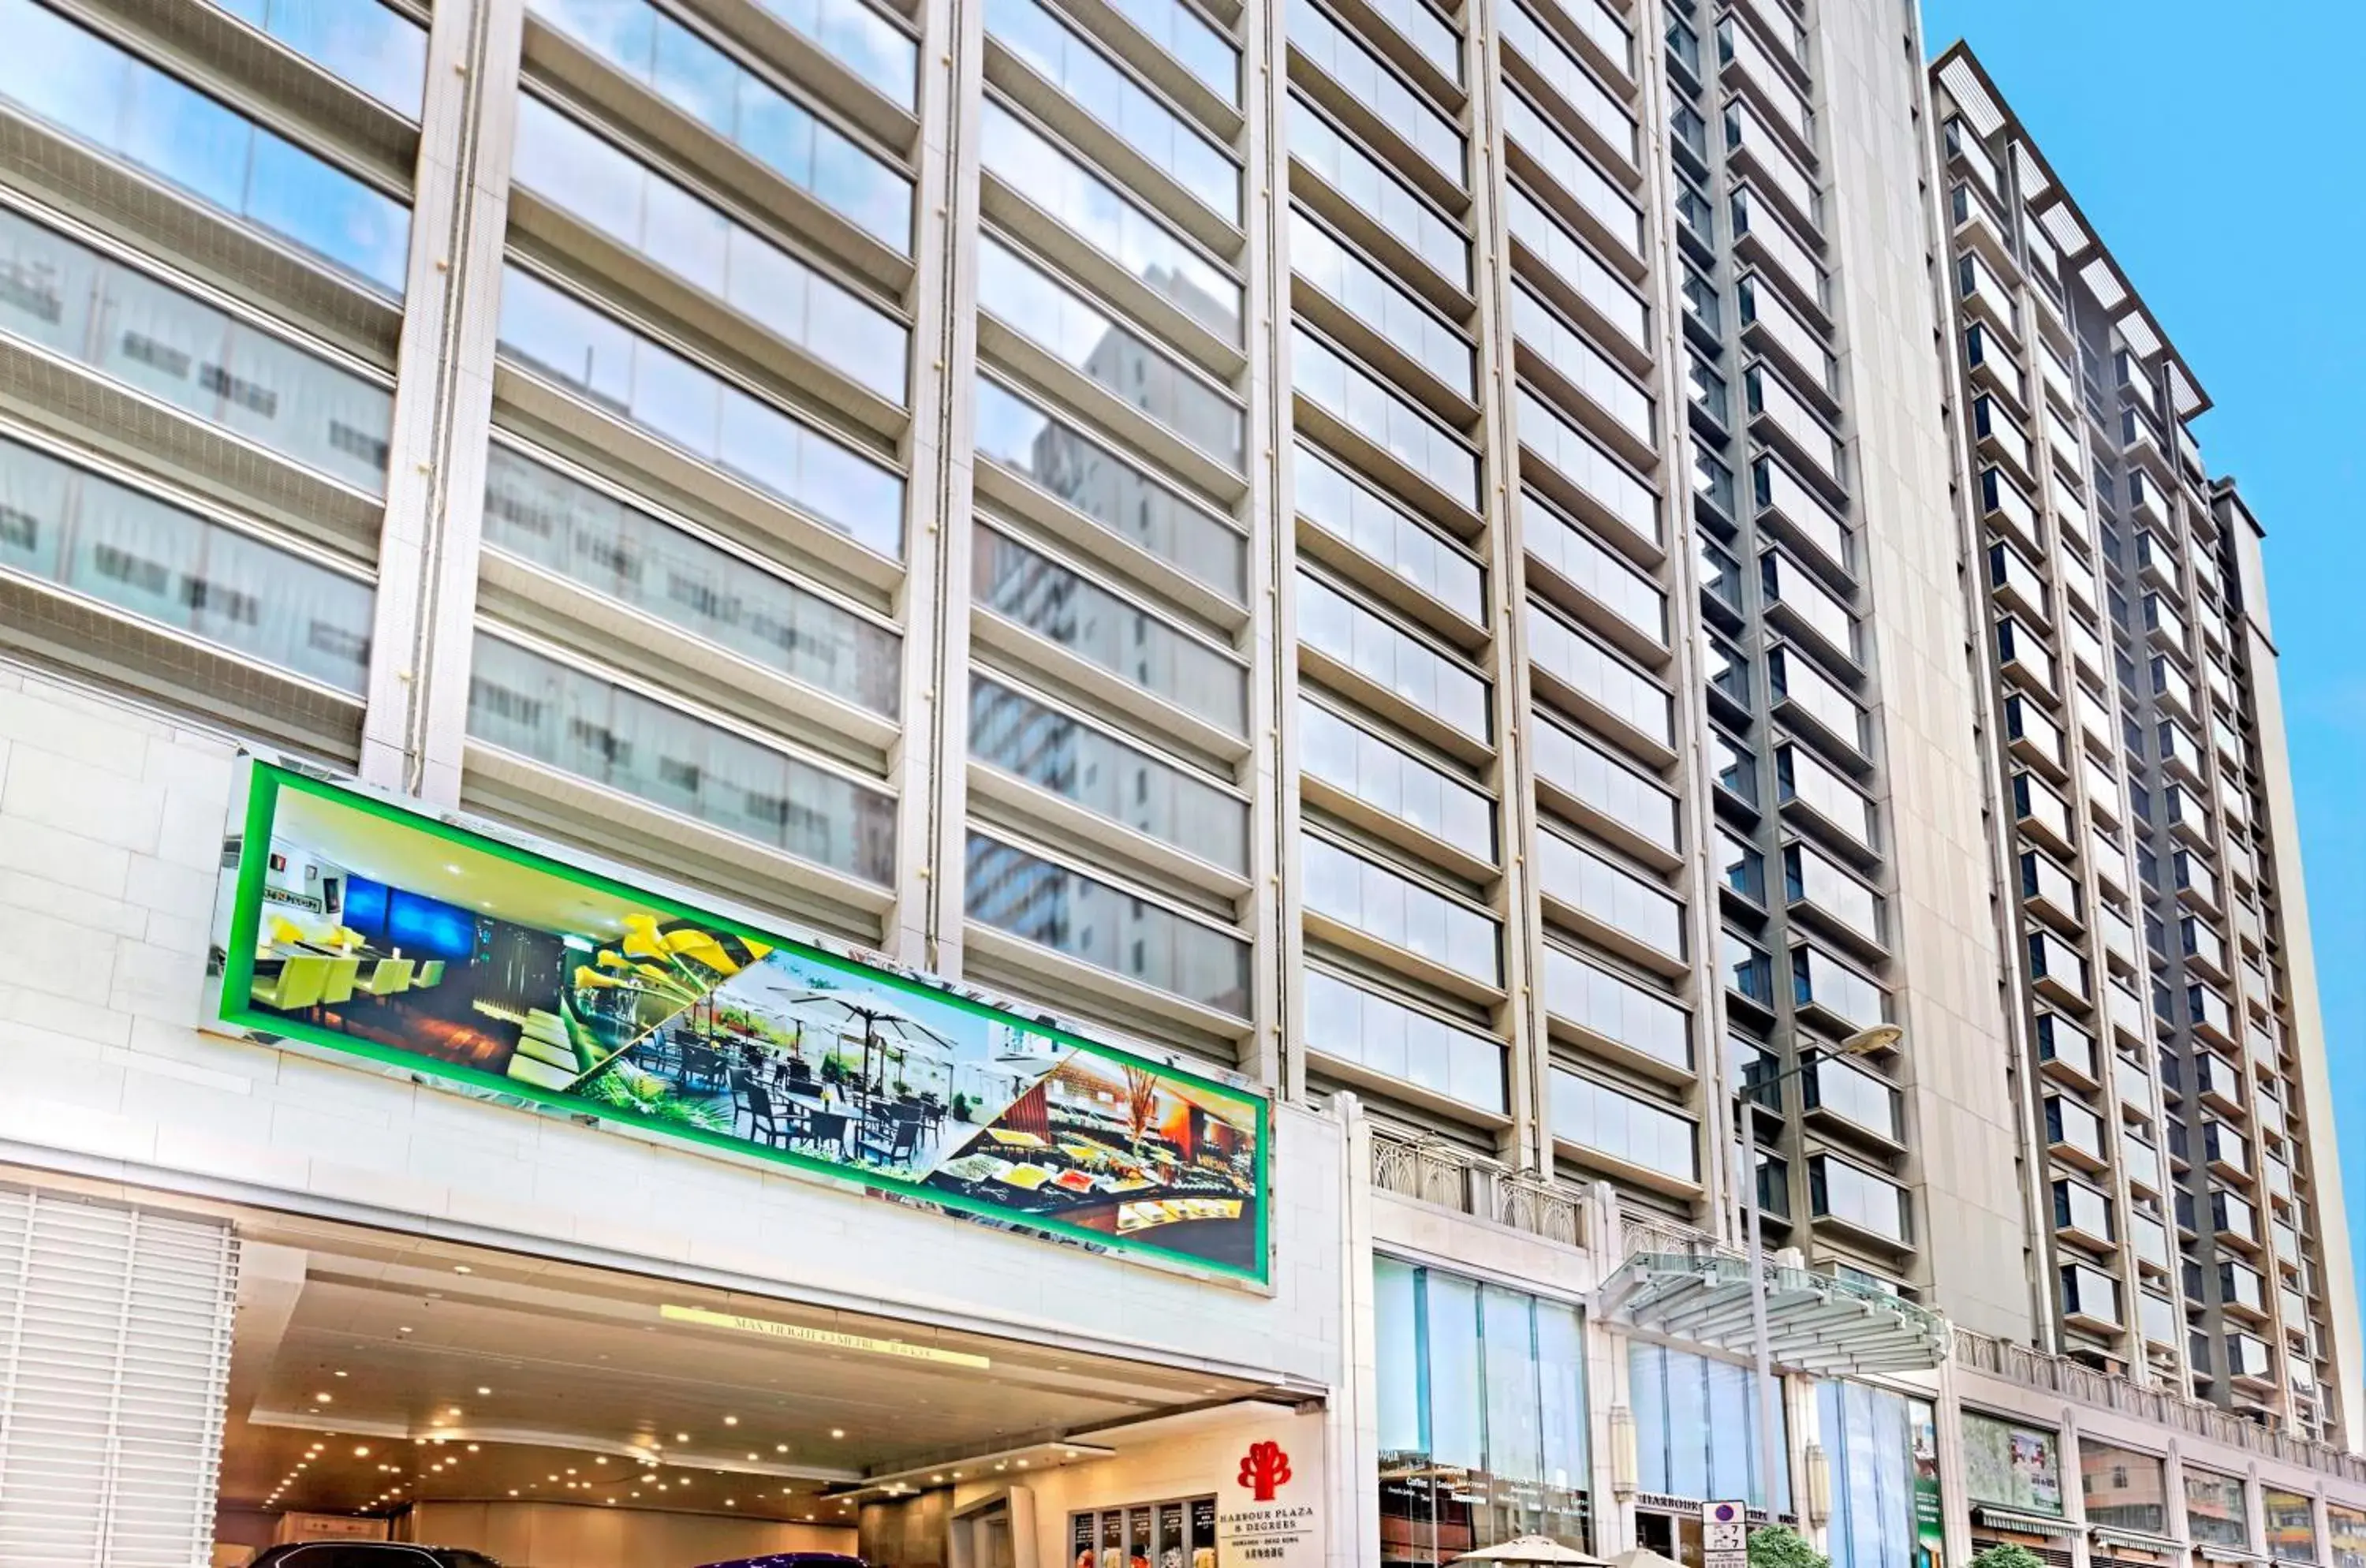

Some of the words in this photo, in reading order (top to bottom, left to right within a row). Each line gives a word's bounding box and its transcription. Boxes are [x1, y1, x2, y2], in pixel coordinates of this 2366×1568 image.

[1220, 1510, 1271, 1523] HARBOUR
[1275, 1506, 1313, 1519] PLAZA
[1246, 1520, 1296, 1532] DEGREES
